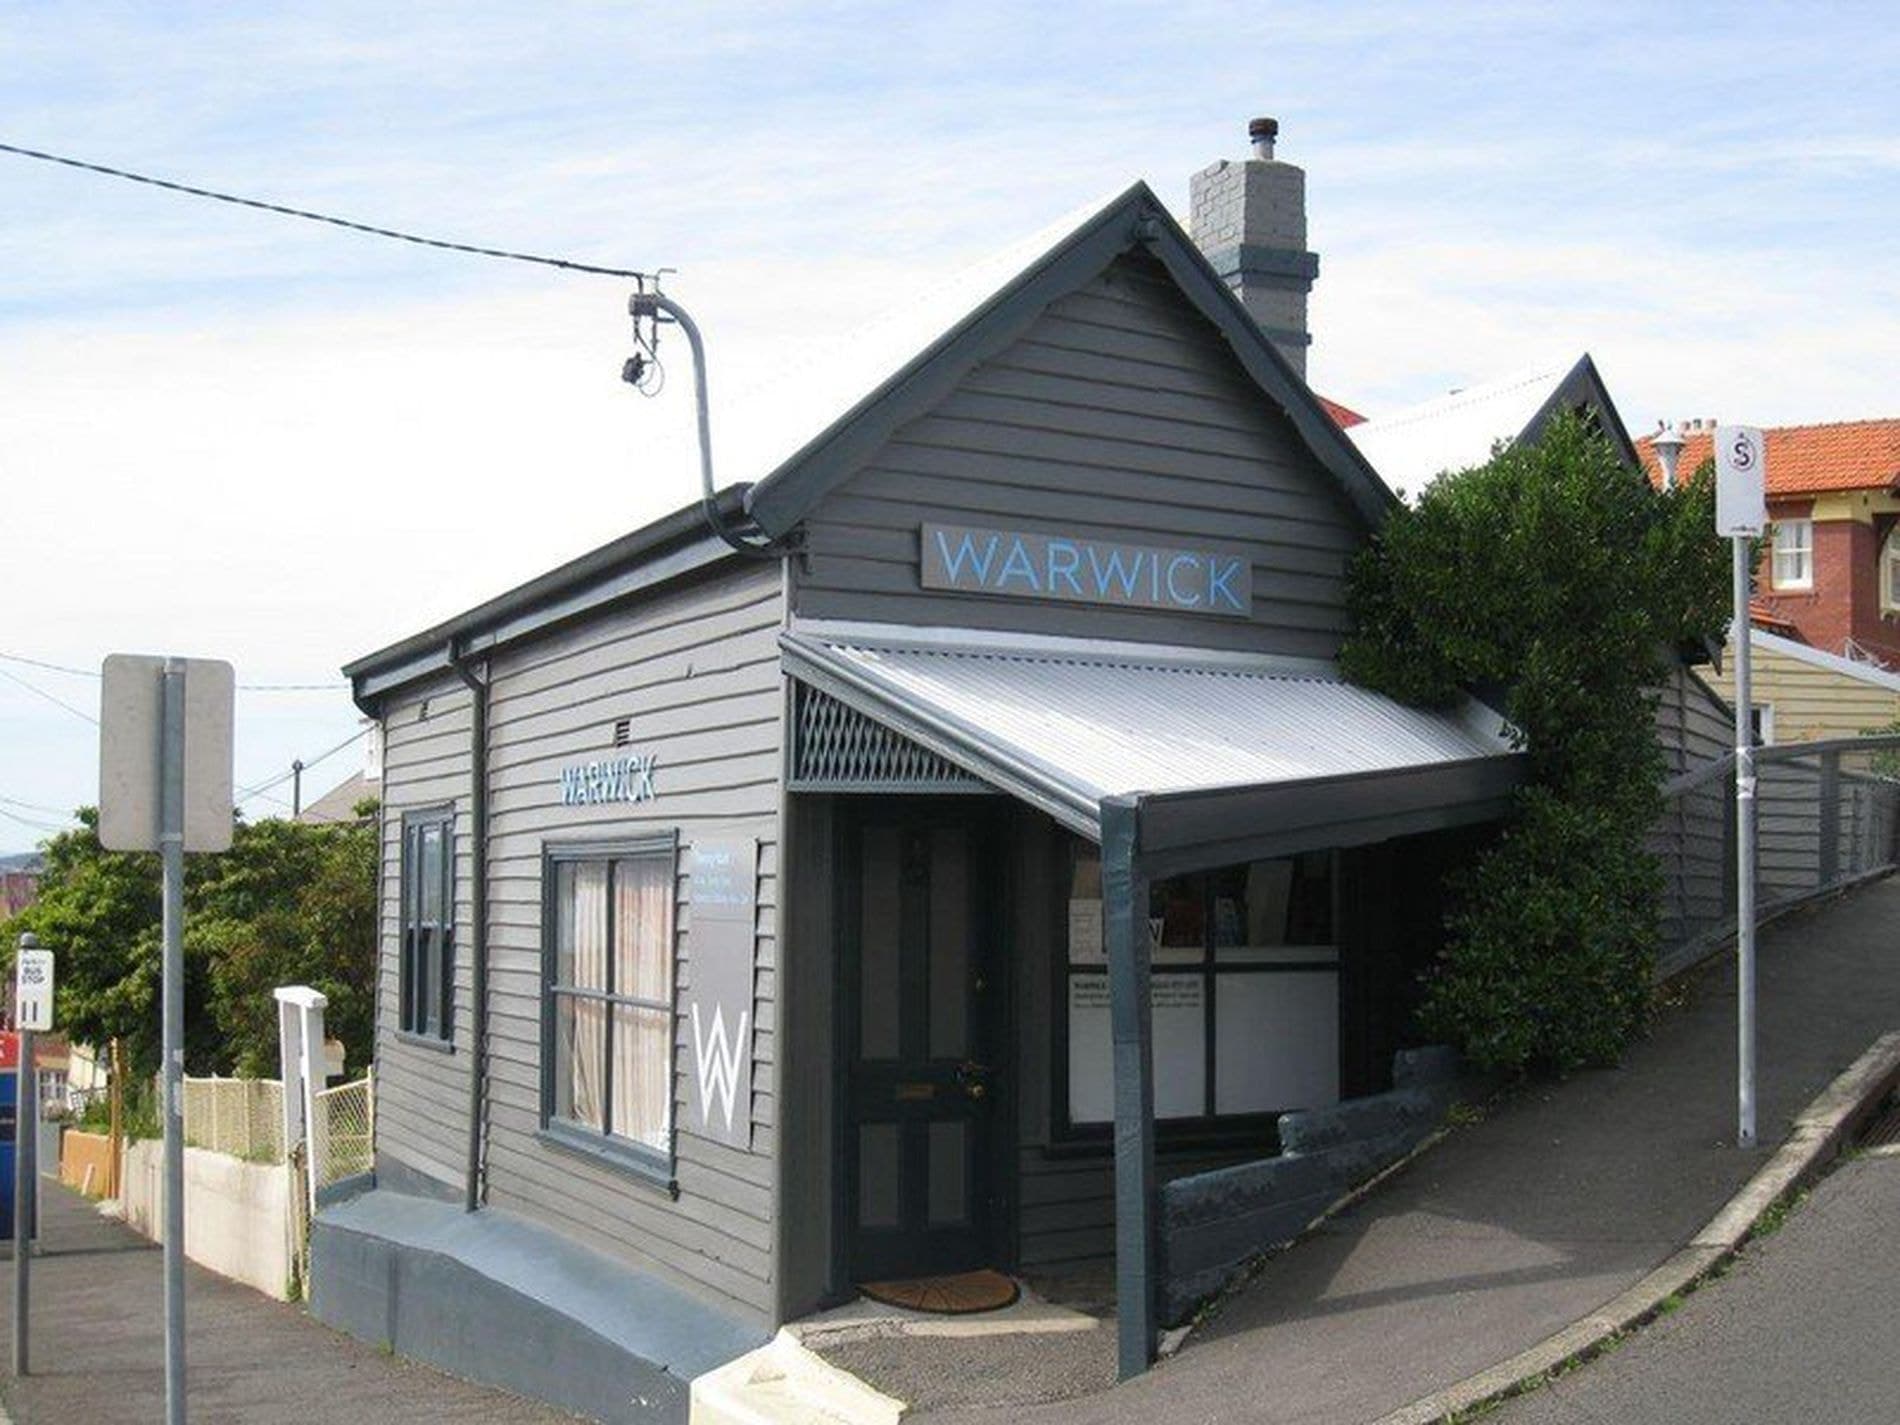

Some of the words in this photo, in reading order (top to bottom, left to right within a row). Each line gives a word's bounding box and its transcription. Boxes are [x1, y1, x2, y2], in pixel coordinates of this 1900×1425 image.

[935, 530, 1244, 610] WARWICK
[561, 753, 657, 806] WARWICK
[21, 975, 46, 985] STOP
[23, 966, 43, 975] BUS
[692, 1001, 747, 1131] W
